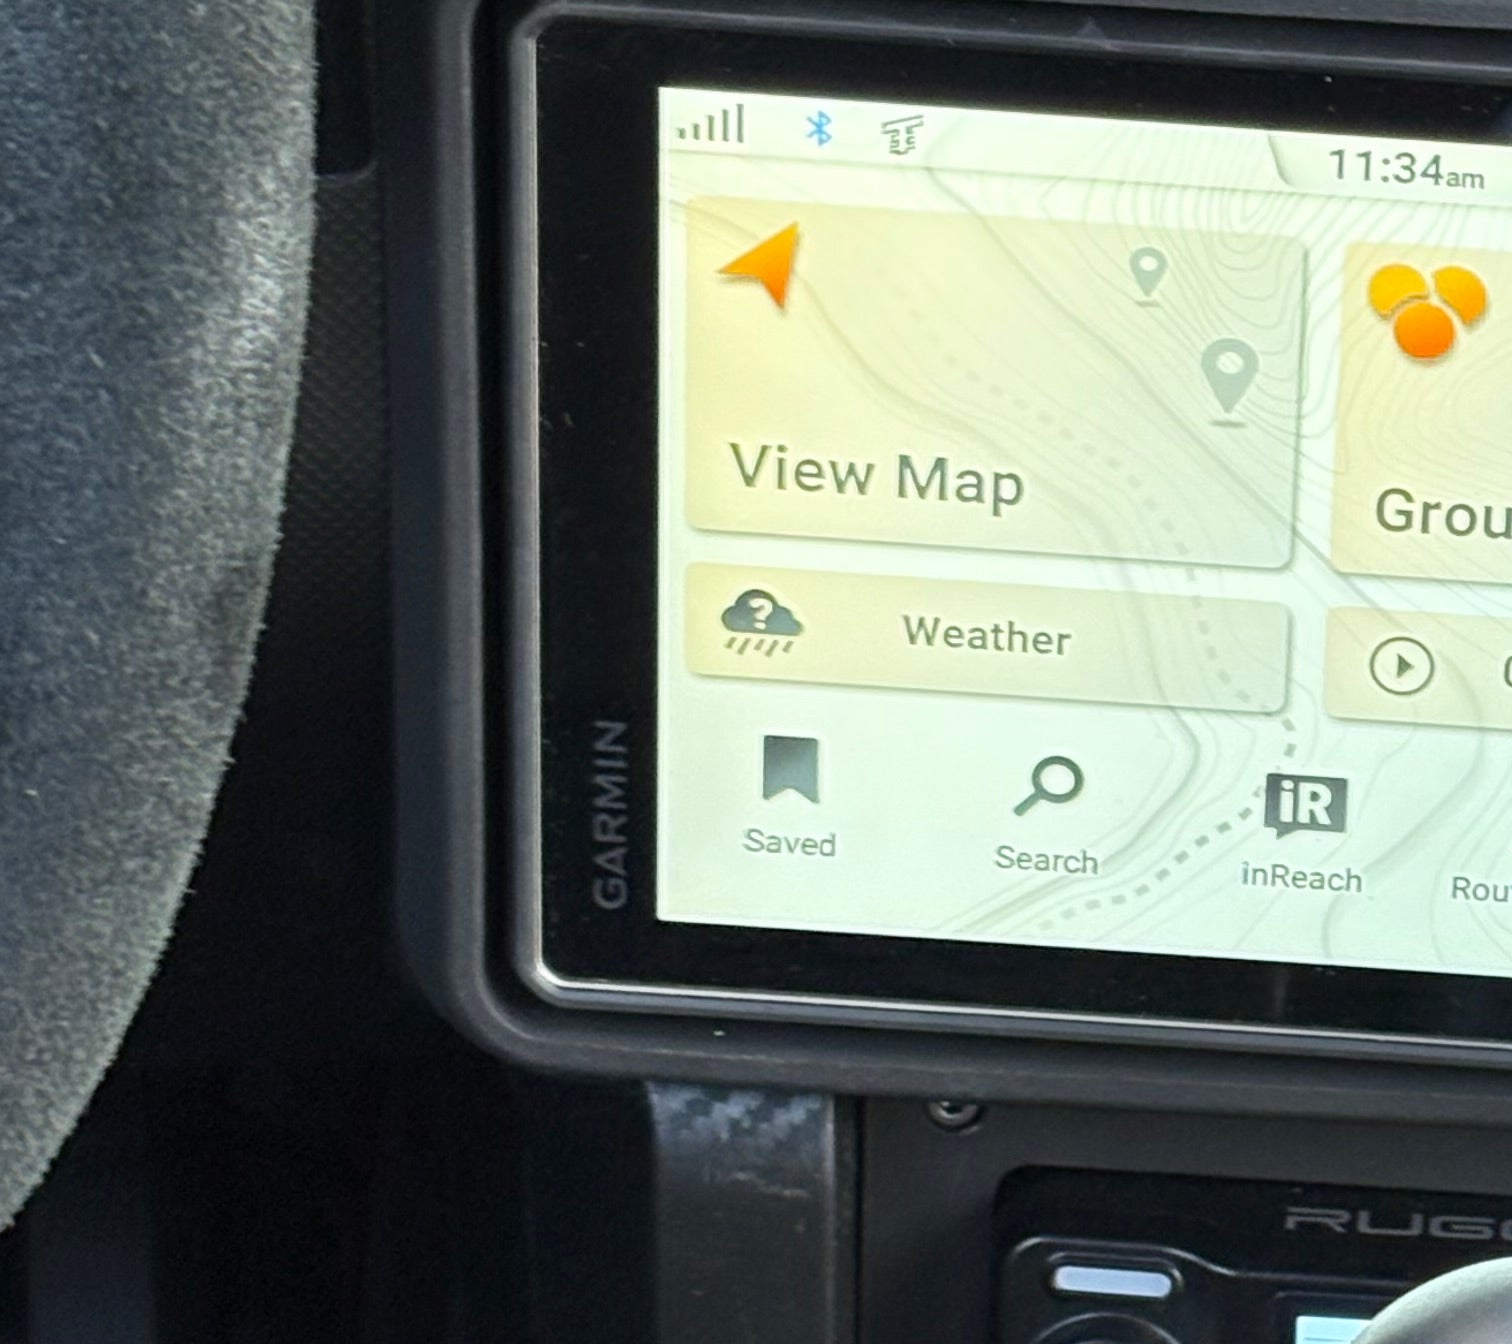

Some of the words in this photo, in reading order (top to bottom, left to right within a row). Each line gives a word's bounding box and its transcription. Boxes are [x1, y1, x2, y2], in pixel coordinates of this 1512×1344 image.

[729, 441, 876, 496] View
[897, 454, 1026, 518] Map
[902, 613, 1073, 656] Weather
[593, 720, 629, 911] GARMIN
[1279, 779, 1332, 825] iR
[742, 827, 837, 858] Saved
[994, 845, 1100, 876] Search
[1241, 860, 1363, 893] inReach
